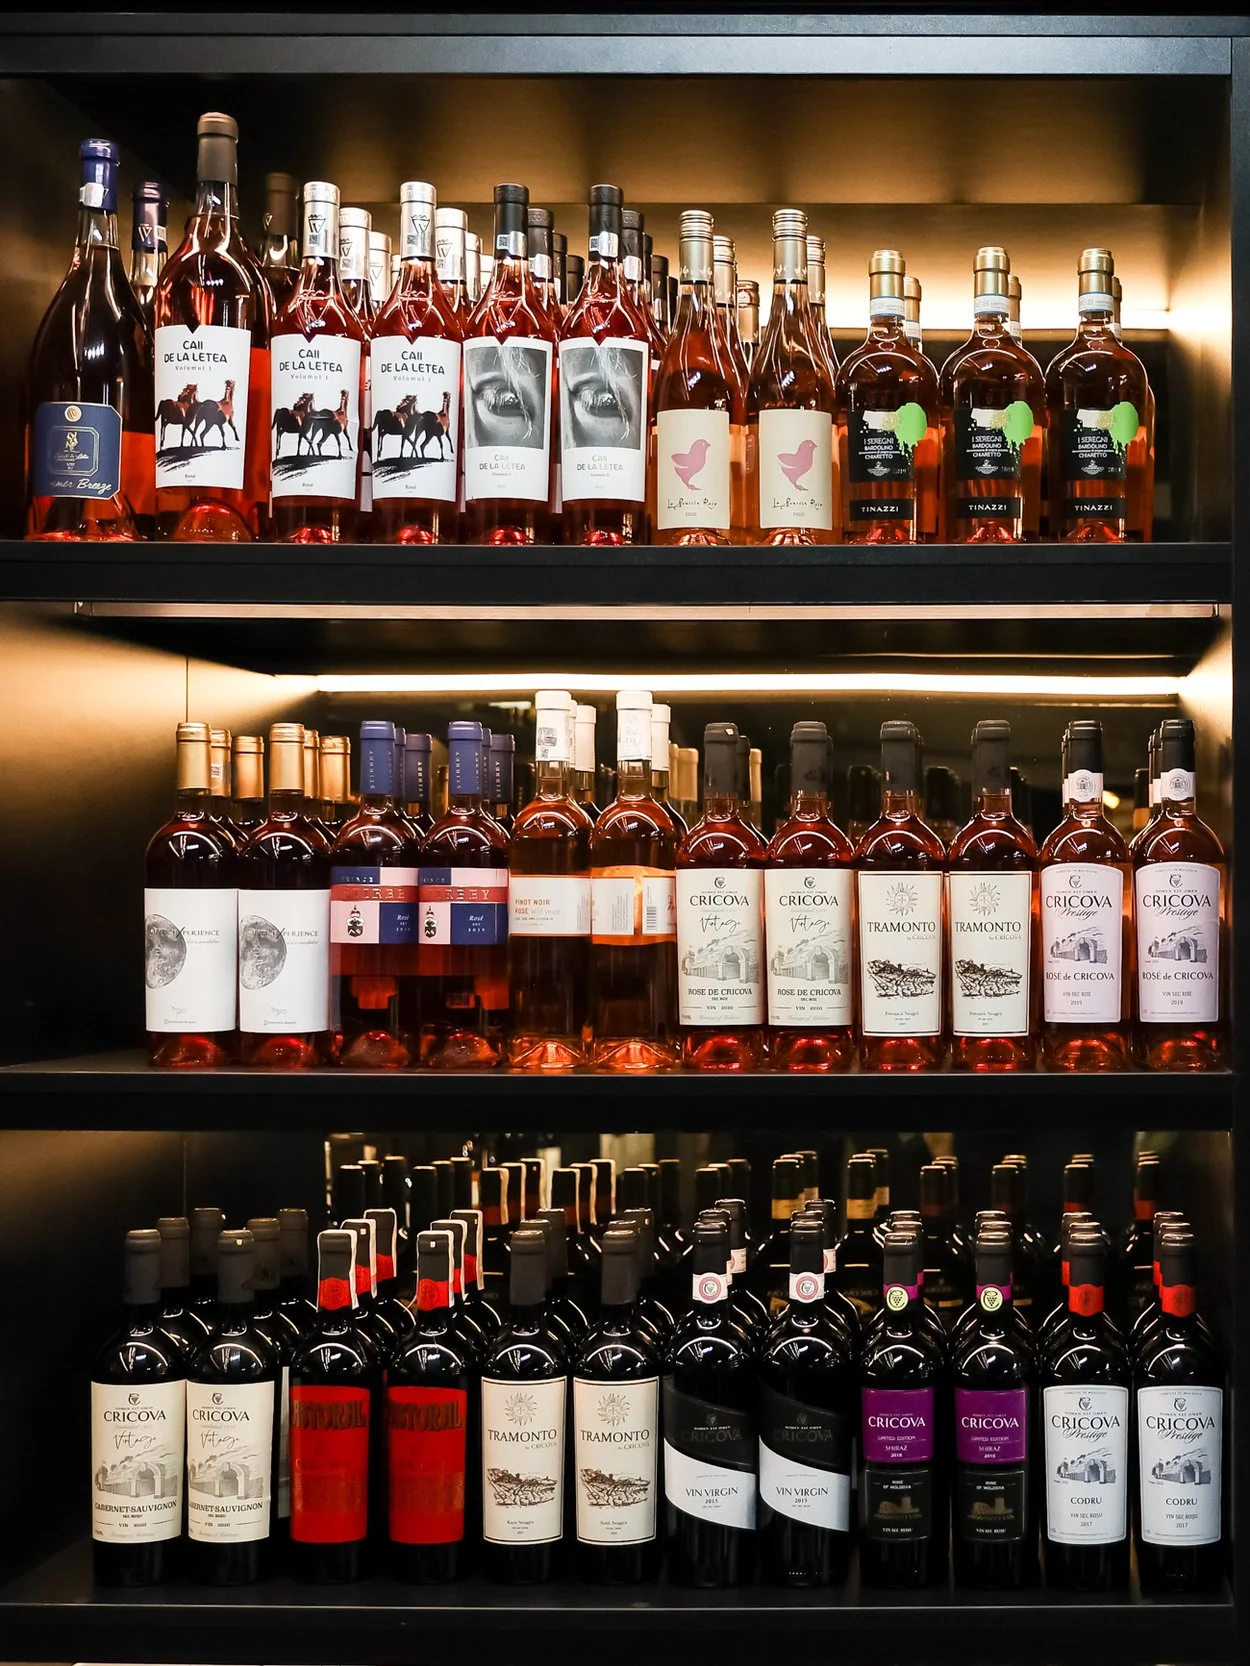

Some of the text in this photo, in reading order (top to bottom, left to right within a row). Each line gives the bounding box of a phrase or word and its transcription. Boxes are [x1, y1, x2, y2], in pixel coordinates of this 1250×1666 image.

[164, 353, 228, 364] DE LA LETEA
[279, 362, 343, 373] DE LA LETEA
[381, 363, 445, 375] DE LA LETEA
[867, 437, 895, 445] SEREGNI
[976, 435, 1003, 444] SEREGNI
[1082, 436, 1109, 444] SEREGNI
[861, 505, 899, 513] TINAZZI
[968, 503, 1007, 512] TINAZZI
[1074, 504, 1113, 512] TINAZZI
[689, 895, 750, 907] CRICOVA
[778, 895, 840, 907] CRICOVA
[1045, 895, 1113, 909] CRICOVA
[1142, 894, 1212, 908] CRICOVA
[867, 921, 937, 933] TRAMONTO
[954, 921, 1022, 933] TRAMONTO
[1062, 971, 1072, 981] de
[1073, 971, 1115, 982] CRICOVA
[1142, 970, 1214, 982] ROSÉ de CRICOVA
[688, 987, 753, 996] ROSE DE CRICOVA
[777, 987, 842, 996] ROSE DE CRICOVA
[103, 1410, 167, 1423] CRICOVA
[191, 1410, 251, 1423] CRICOVA
[868, 1416, 926, 1429] CRICOVA
[961, 1416, 1020, 1429] CRICOVA
[1051, 1415, 1121, 1429] CRICOVA
[1145, 1415, 1216, 1429] CRICOVA
[487, 1429, 558, 1443] TRAMONTO
[580, 1429, 650, 1443] TRAMONTO
[684, 1486, 739, 1497] VIN VIRGIN
[776, 1486, 829, 1497] VIN VIRGIN
[1070, 1496, 1102, 1505] CODRU
[1165, 1496, 1198, 1506] CODRU
